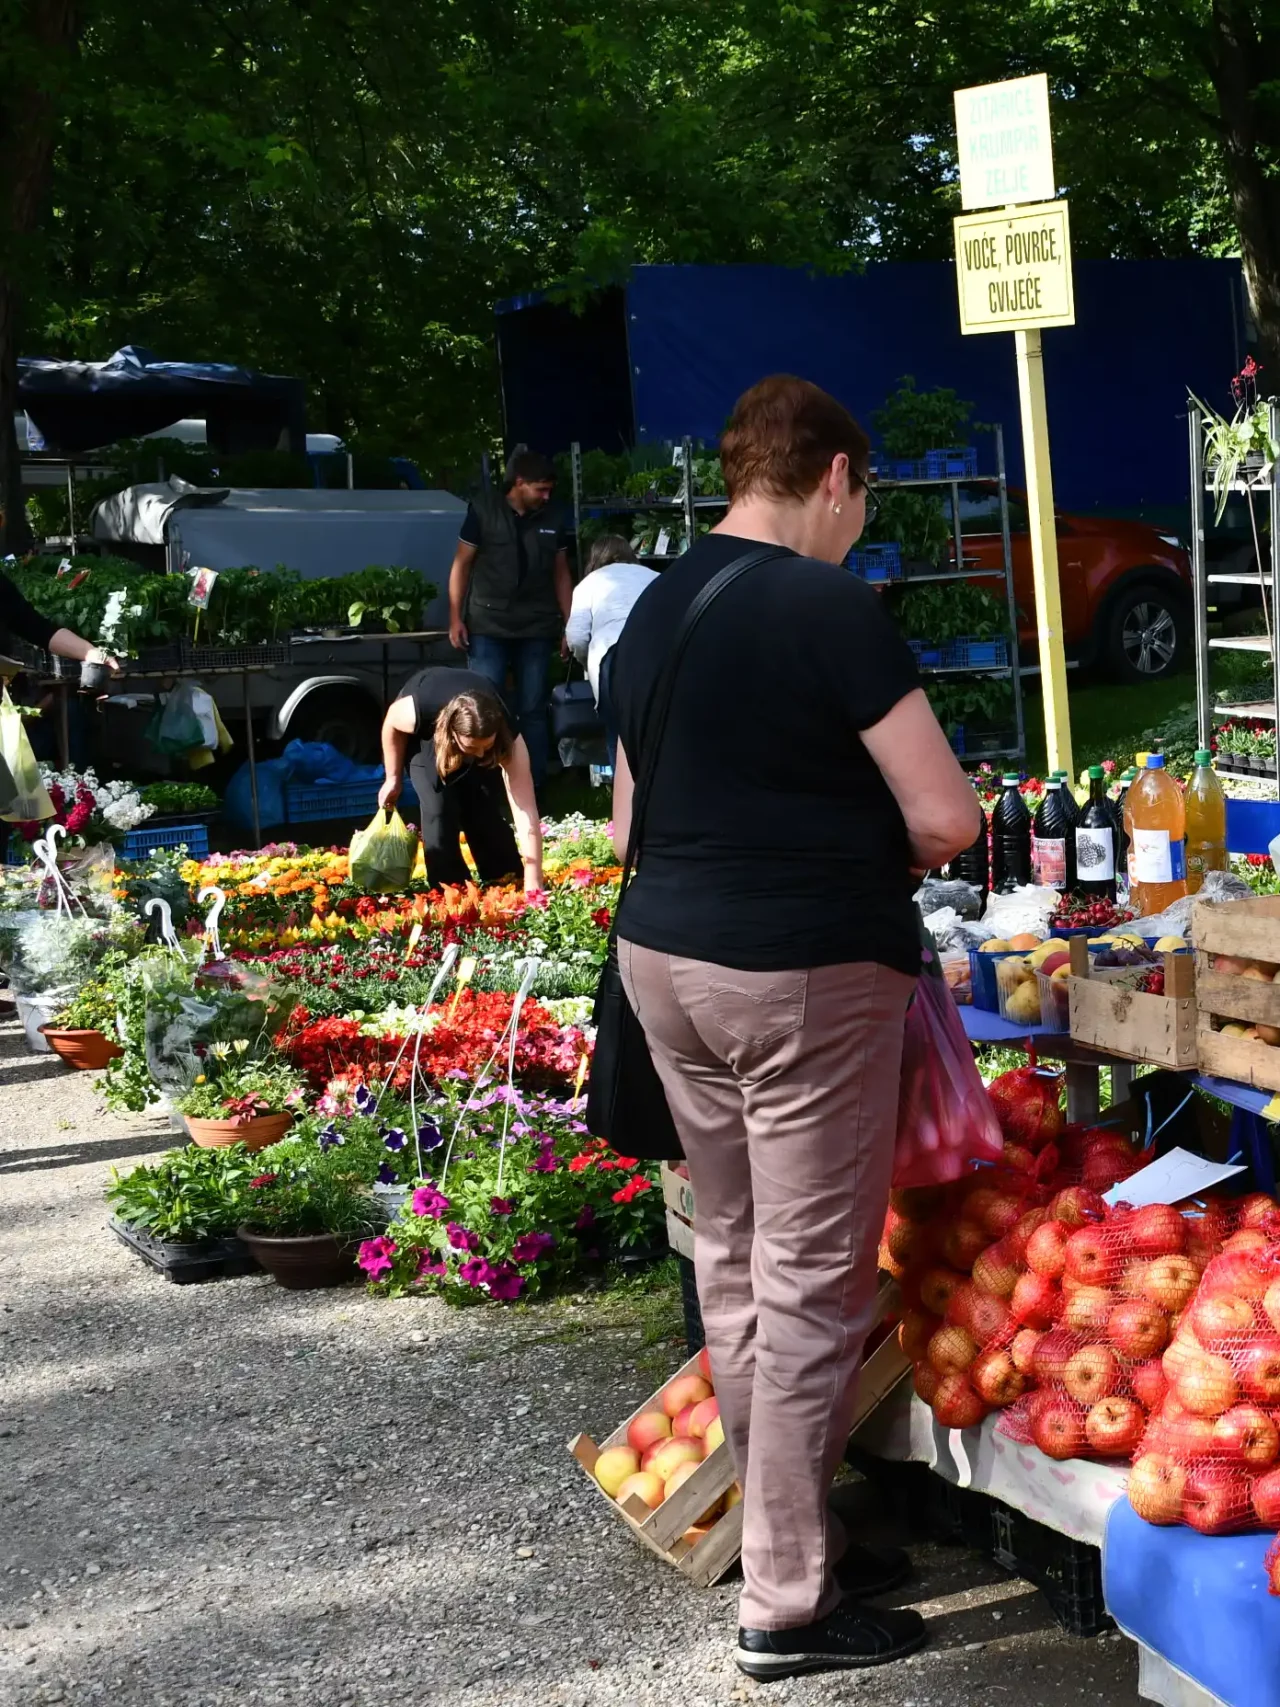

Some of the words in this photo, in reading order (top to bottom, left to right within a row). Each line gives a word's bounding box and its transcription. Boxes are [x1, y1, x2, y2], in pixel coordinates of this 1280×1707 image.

[969, 124, 1039, 164] KRUMPIR
[985, 164, 1029, 196] ZELJE
[964, 232, 1002, 273] VOĆE,
[1005, 223, 1062, 265] POVRĆE,
[988, 272, 1042, 313] CVIJEĆE
